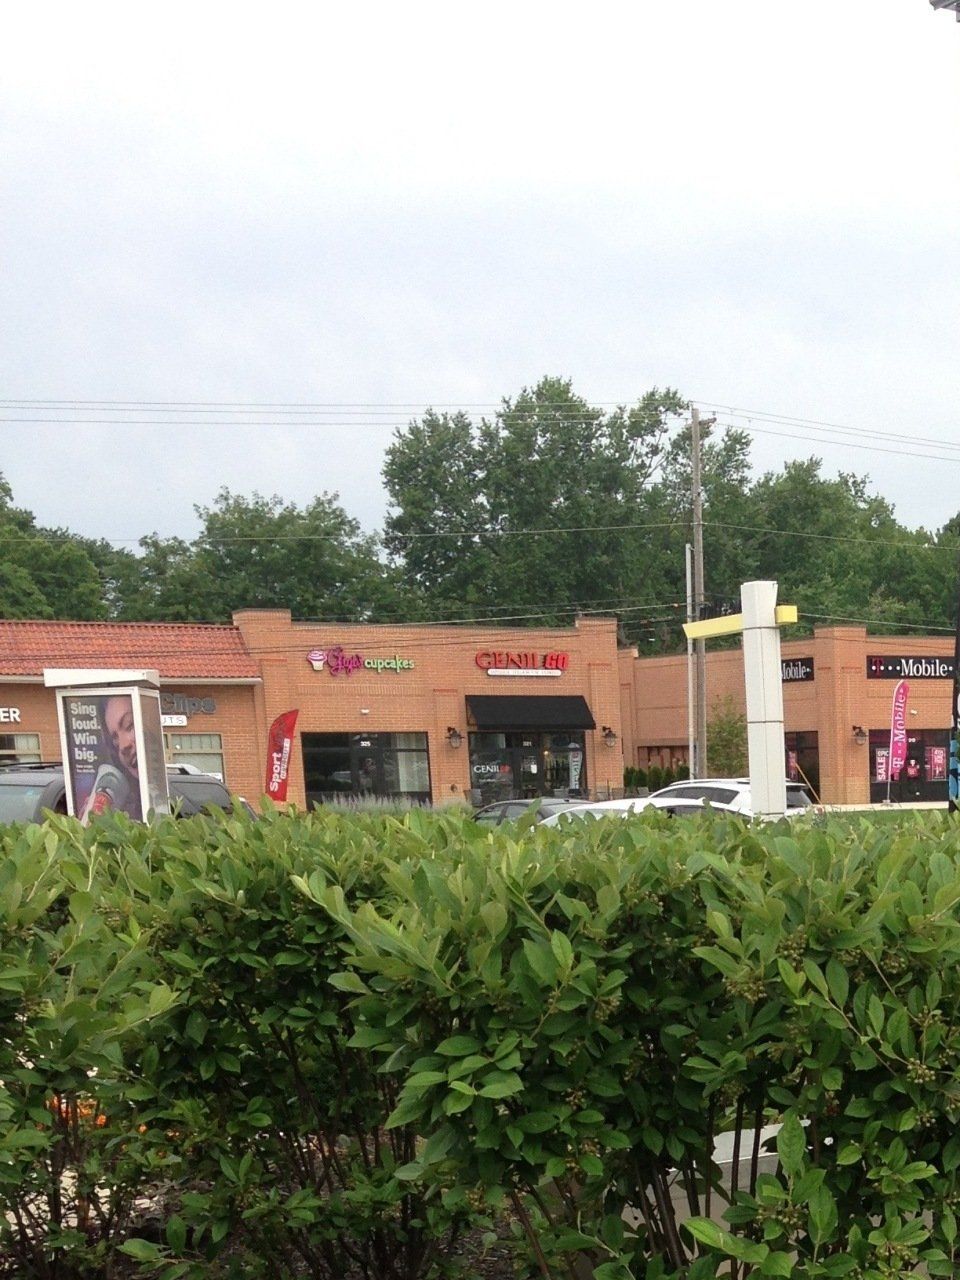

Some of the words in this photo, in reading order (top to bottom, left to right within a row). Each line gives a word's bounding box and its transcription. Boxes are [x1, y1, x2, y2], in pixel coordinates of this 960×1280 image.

[364, 655, 415, 673] cupcakes
[901, 658, 948, 677] Mobile
[70, 702, 97, 717] Sing
[893, 694, 907, 742] Mobile
[72, 717, 101, 730] loud.
[73, 732, 98, 745] Win
[74, 747, 98, 763] big.
[269, 752, 282, 792] Sport
[877, 756, 887, 780] SALE
